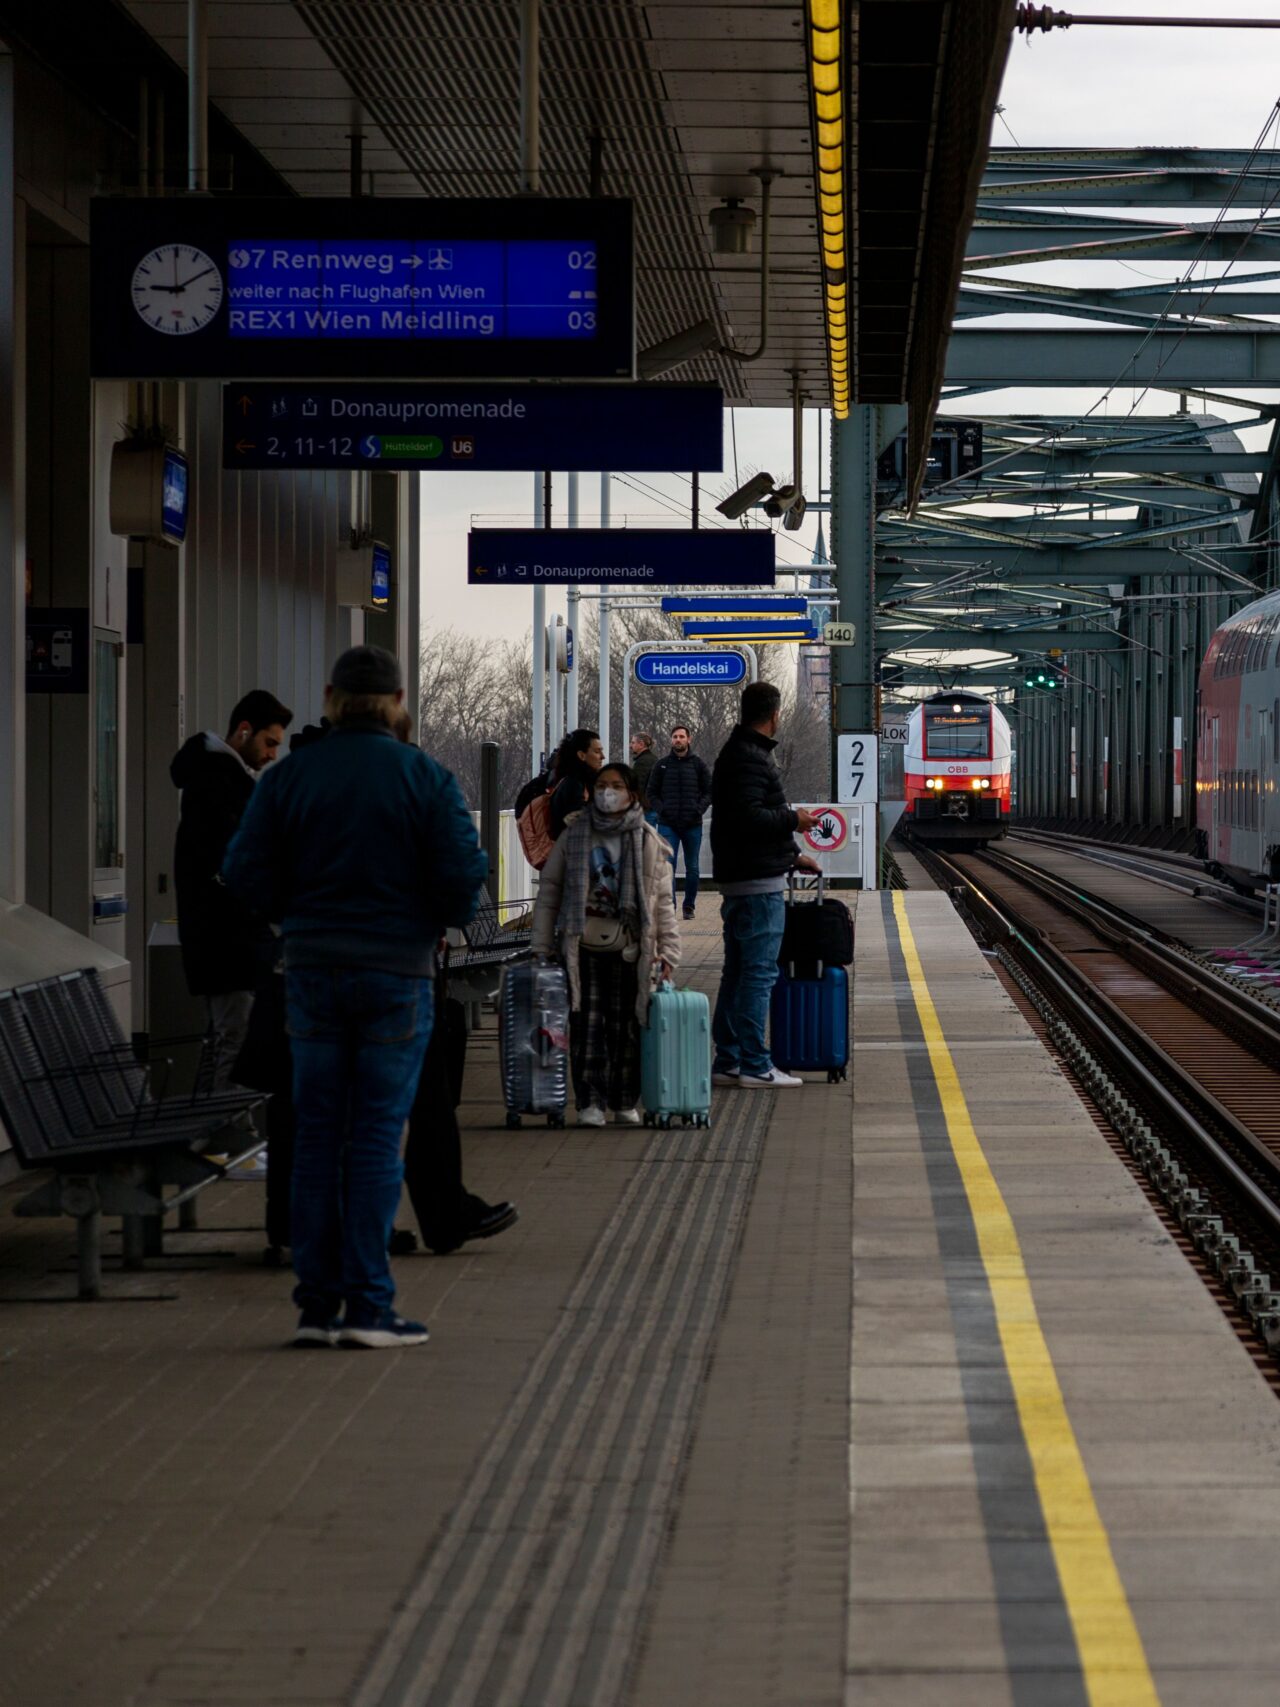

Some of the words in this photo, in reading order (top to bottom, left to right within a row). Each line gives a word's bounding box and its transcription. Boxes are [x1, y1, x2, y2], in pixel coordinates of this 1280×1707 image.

[272, 249, 394, 274] Rennweg
[567, 250, 598, 270] 02
[227, 283, 283, 299] weiter
[288, 283, 334, 299] nach
[340, 283, 432, 303] Flughafen
[438, 284, 486, 299] Wien
[229, 310, 296, 330] REX1
[304, 310, 371, 330] Wien
[381, 310, 495, 335] Meidling
[567, 310, 598, 330] 03
[330, 398, 526, 423] Donaupromenade
[266, 437, 287, 459] 2,
[293, 437, 353, 456] 11-12
[451, 441, 473, 454] U6
[533, 564, 655, 580] Donaupromenade
[828, 628, 851, 641] 140
[652, 661, 729, 675] Handelskai
[883, 728, 907, 740] LOK
[851, 741, 864, 766] 2
[851, 772, 864, 797] 7
